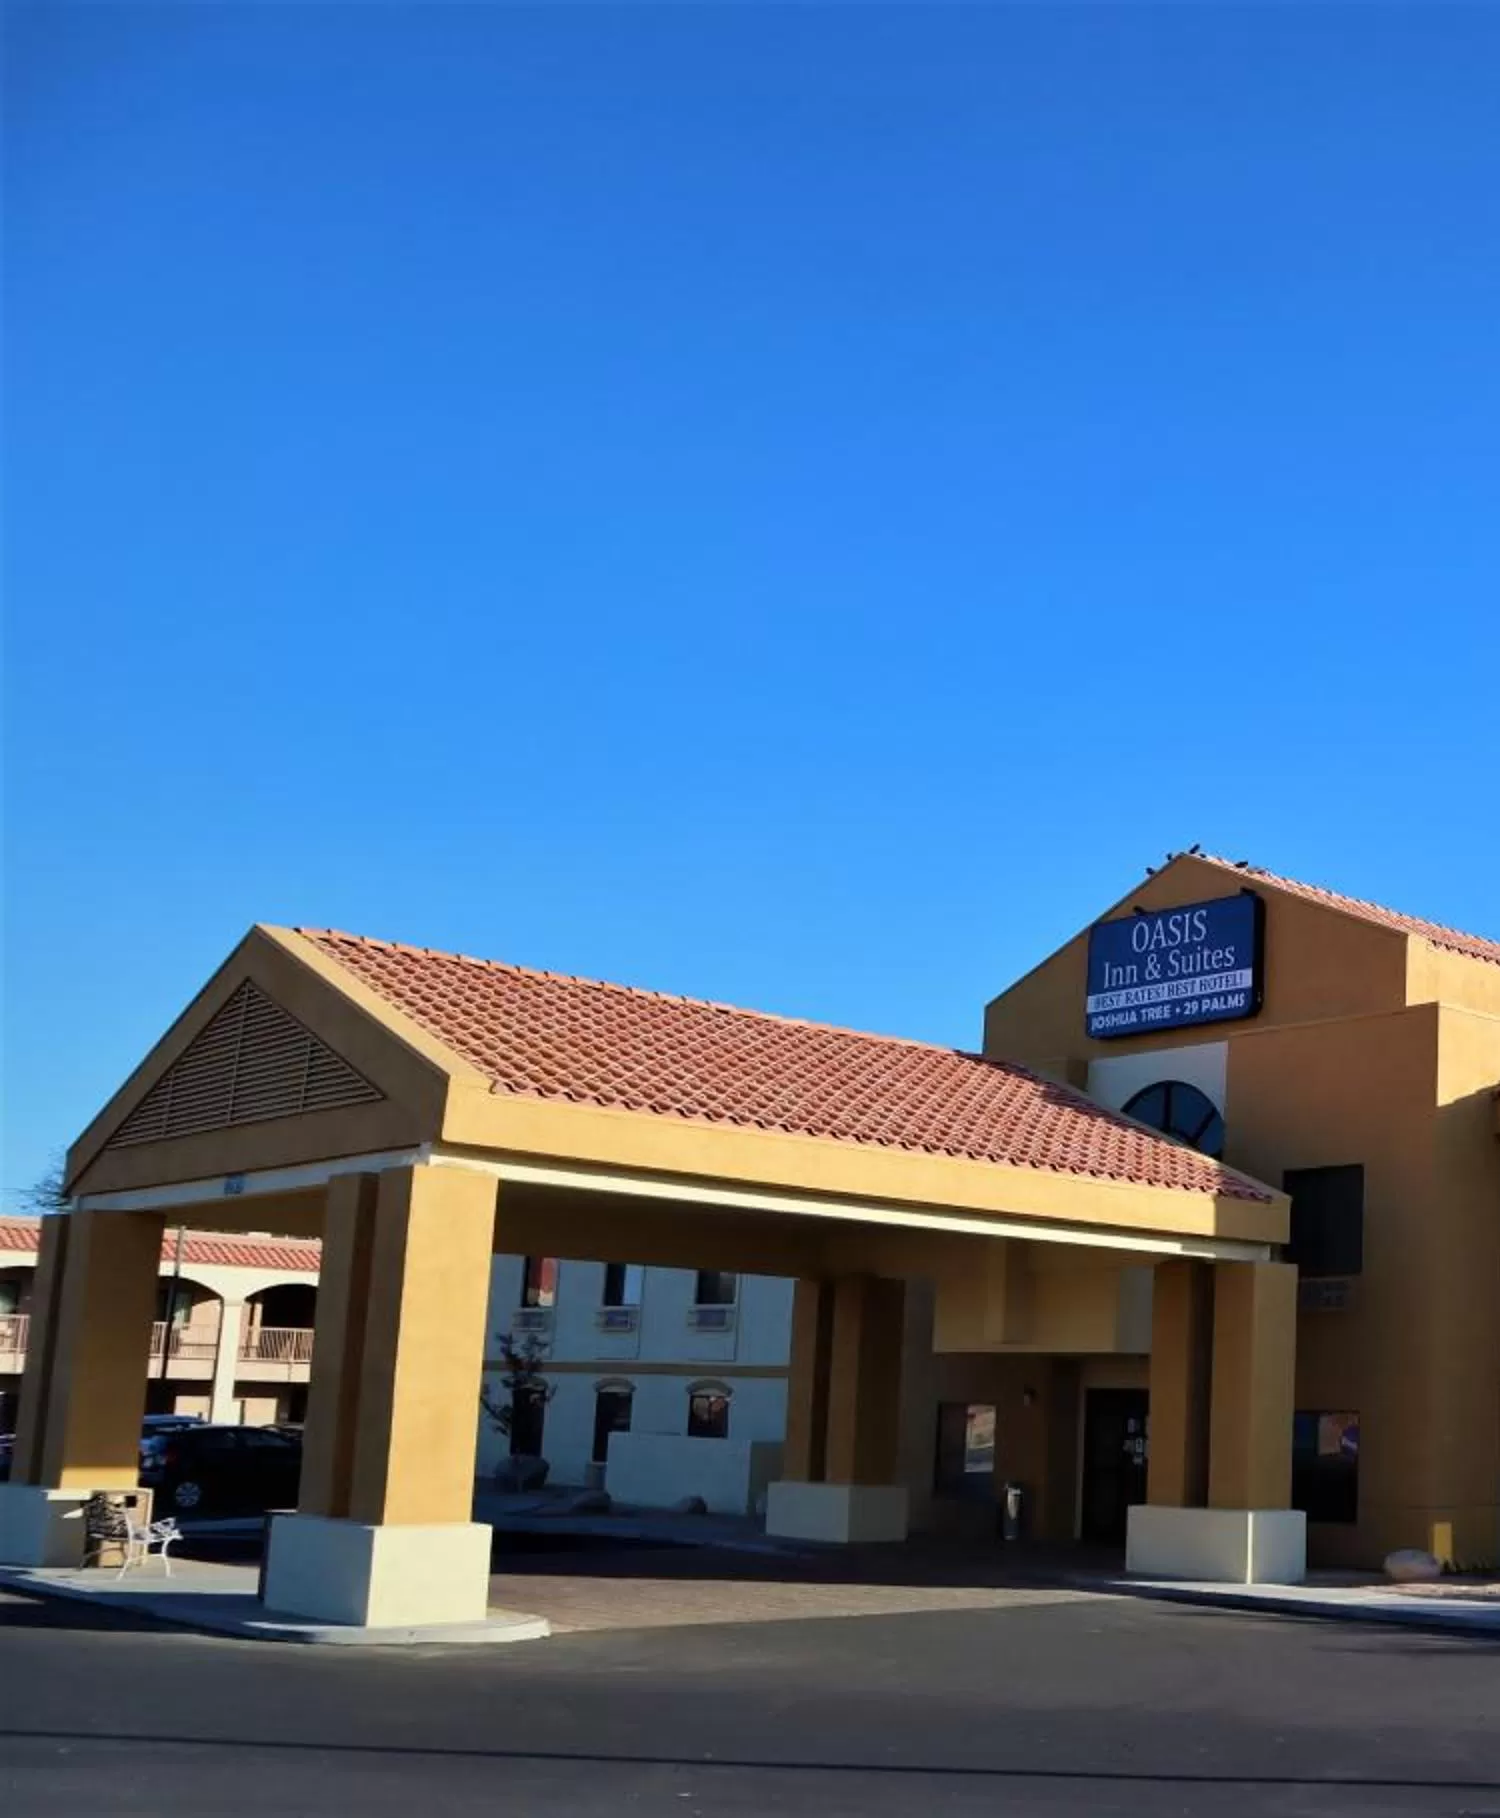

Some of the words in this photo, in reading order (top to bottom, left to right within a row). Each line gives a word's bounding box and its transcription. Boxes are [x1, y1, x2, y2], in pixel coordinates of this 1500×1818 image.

[1132, 909, 1208, 953] OASIS
[1104, 961, 1137, 989] Inn
[1145, 953, 1162, 981] &
[1168, 945, 1235, 977] Suites
[1091, 1008, 1138, 1030] JOSHUA
[1140, 1004, 1171, 1022] TREE
[1183, 1000, 1199, 1015] 29
[1201, 992, 1245, 1013] PALMS
